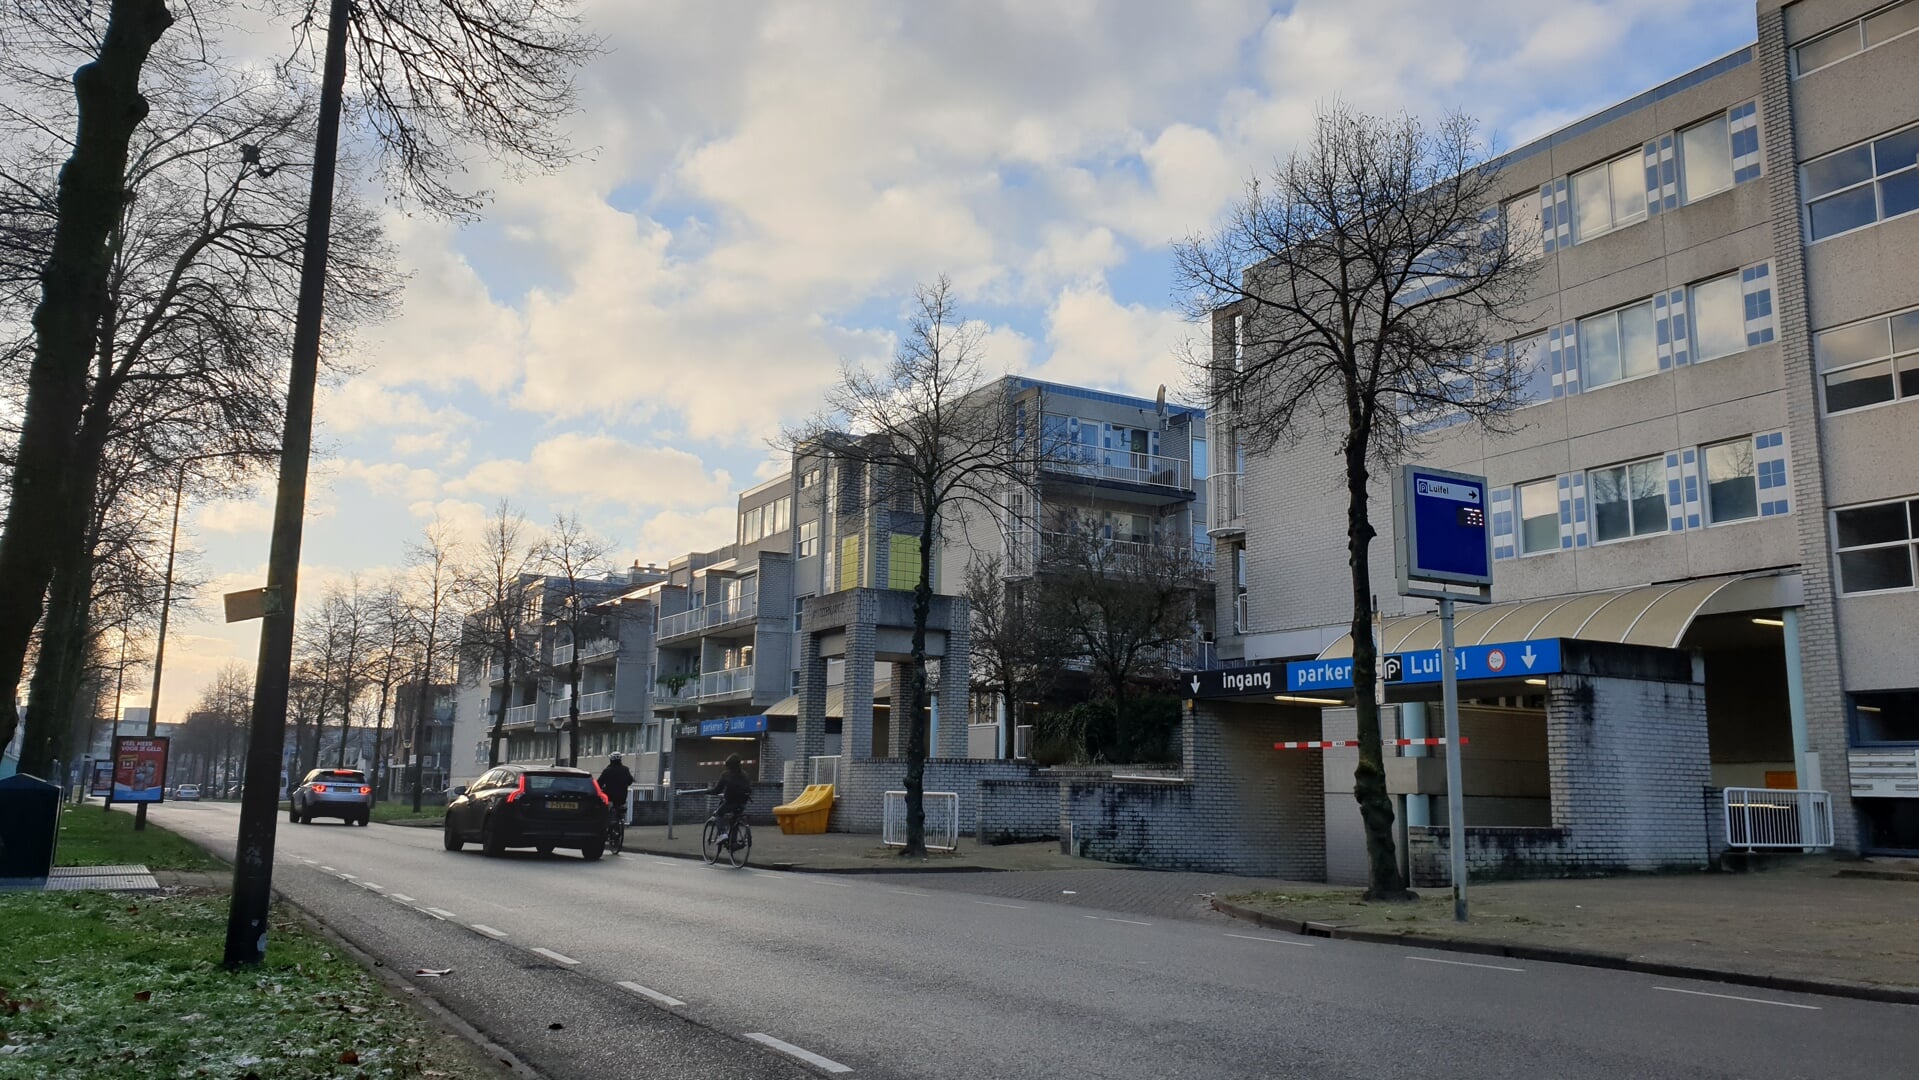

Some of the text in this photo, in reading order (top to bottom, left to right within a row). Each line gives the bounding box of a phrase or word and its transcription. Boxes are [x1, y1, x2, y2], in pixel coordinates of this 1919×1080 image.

[1428, 484, 1449, 495] Luifel
[1222, 671, 1272, 692] ingang
[1298, 663, 1352, 686] parker
[1410, 651, 1467, 675] Luiel
[703, 722, 723, 735] parkeren
